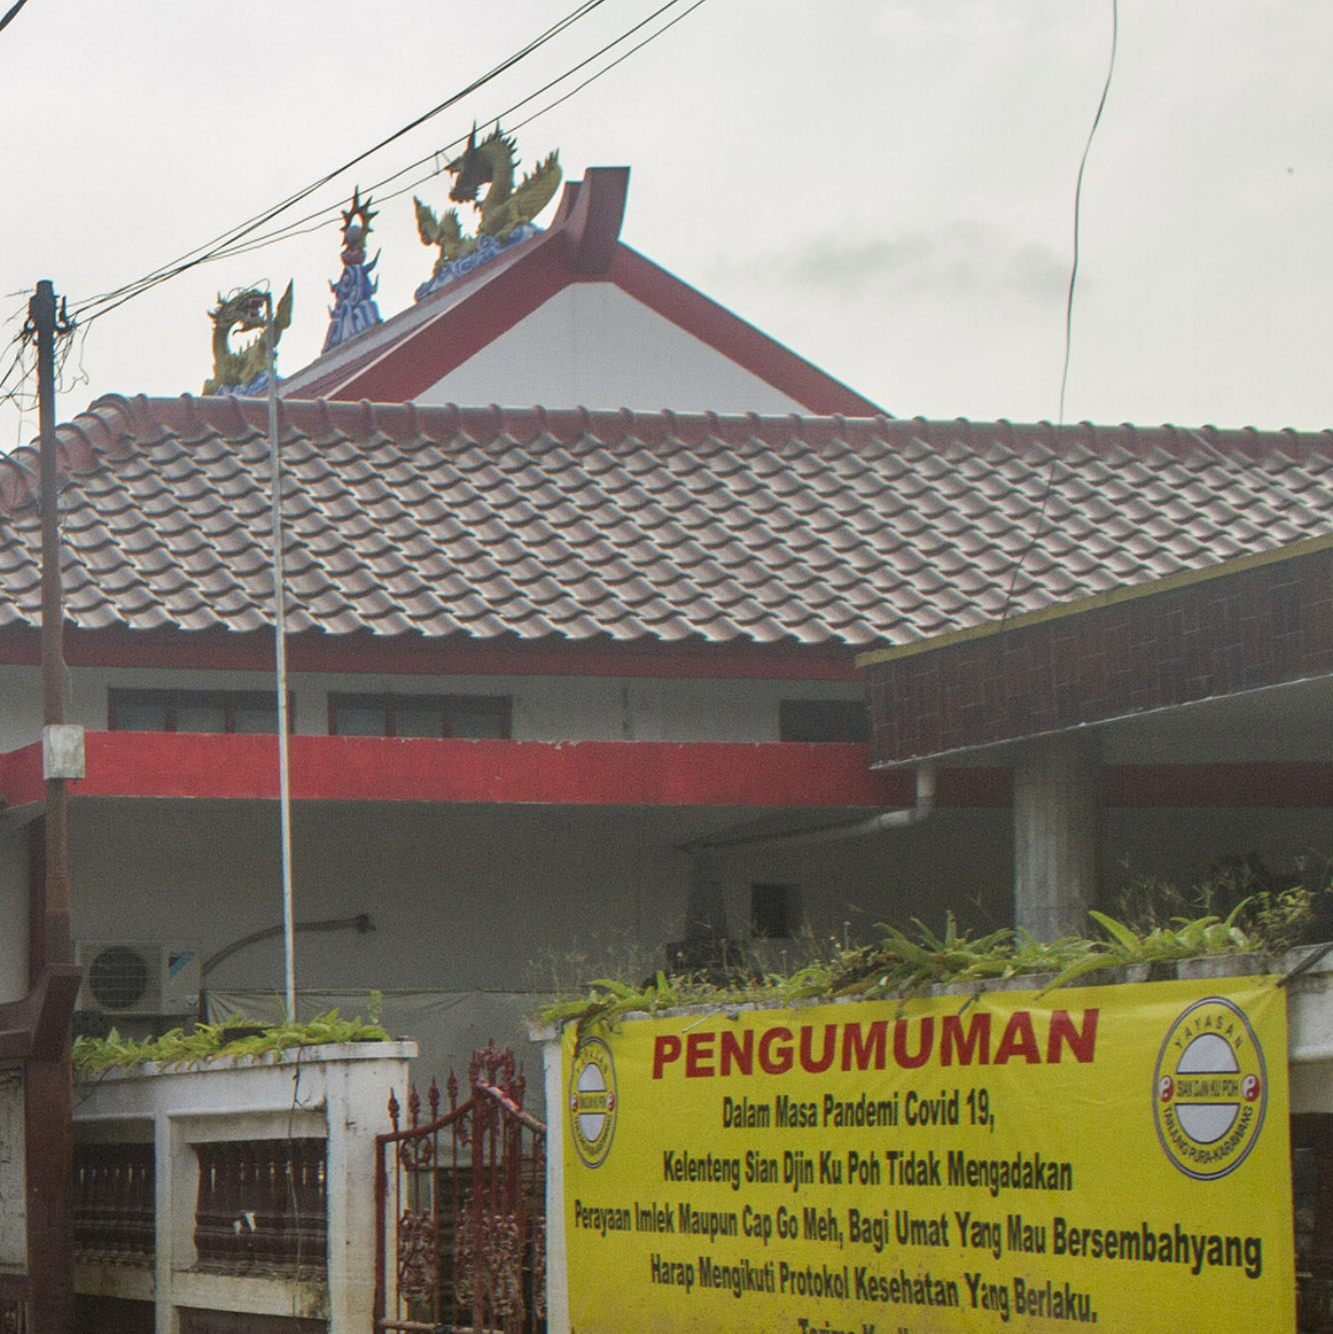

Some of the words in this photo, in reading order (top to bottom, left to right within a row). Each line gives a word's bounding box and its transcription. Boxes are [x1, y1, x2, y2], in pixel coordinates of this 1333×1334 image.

[652, 1008, 1100, 1080] PENGUMUMAN
[1174, 1015, 1244, 1050] YAYASAN
[722, 1096, 771, 1129] Dalam
[775, 1095, 818, 1128] Masa
[823, 1092, 900, 1128] Pandemi
[905, 1089, 960, 1126] Covid
[967, 1088, 996, 1133] 19,
[1222, 1079, 1239, 1097] POH
[663, 1151, 740, 1191] Kelenteng
[745, 1151, 778, 1184] Sian
[783, 1151, 814, 1192] Djin
[819, 1151, 842, 1185] Ku
[848, 1151, 881, 1186] Poh
[886, 1151, 942, 1187] Tidak
[947, 1151, 1073, 1198] Mengadakan
[574, 1199, 632, 1237] Perayaan
[634, 1202, 675, 1233] Imlek
[678, 1203, 739, 1242] Maupun
[742, 1204, 772, 1246] Cap
[776, 1206, 798, 1240] Go
[803, 1207, 845, 1249] Meh,
[848, 1208, 889, 1253] Bagi
[896, 1210, 949, 1248] Umat
[955, 1211, 1002, 1260] Yang
[1007, 1214, 1046, 1254] Mau
[1053, 1216, 1263, 1280] Bersembahyang
[651, 1253, 694, 1294] Harap
[699, 1256, 775, 1298] Mengikuti
[779, 1261, 850, 1299] Protokol
[854, 1266, 959, 1308] Kesehatan
[964, 1272, 1010, 1323] Yang
[1014, 1276, 1097, 1323] Berlaku.
